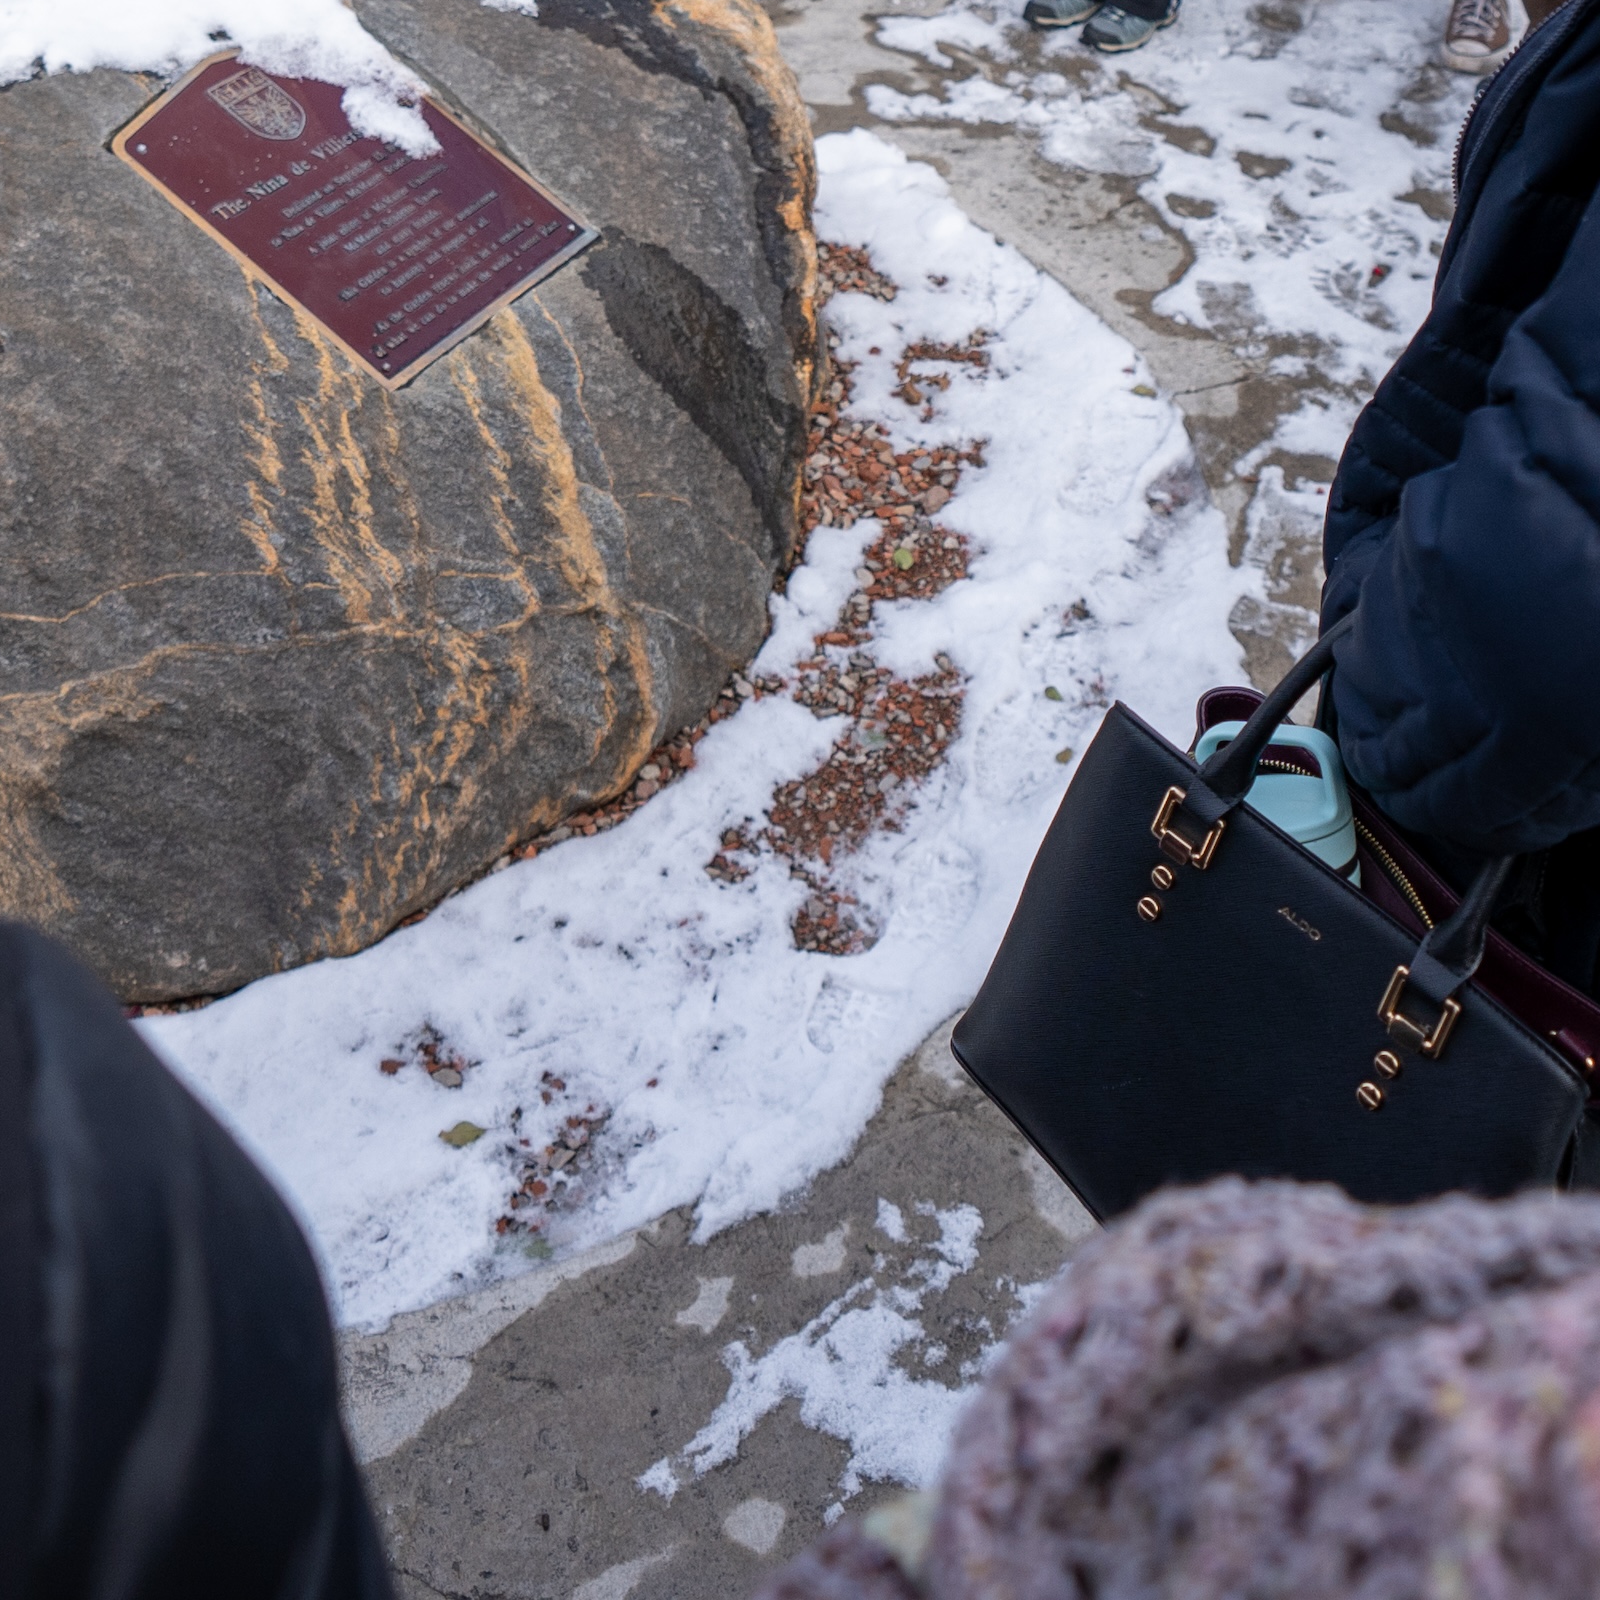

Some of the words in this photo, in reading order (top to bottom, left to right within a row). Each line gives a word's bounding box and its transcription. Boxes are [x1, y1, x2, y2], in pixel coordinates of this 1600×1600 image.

[211, 196, 250, 220] The
[246, 172, 290, 200] Nina
[287, 158, 313, 175] de
[280, 222, 305, 239] Nina
[302, 215, 317, 226] de
[345, 172, 387, 198] McMaster
[306, 245, 318, 254] A
[370, 186, 411, 213] McMaster
[343, 225, 384, 253] McMaster
[357, 265, 390, 288] Garden
[402, 289, 434, 312] Garden
[1277, 907, 1321, 941] ALDO
